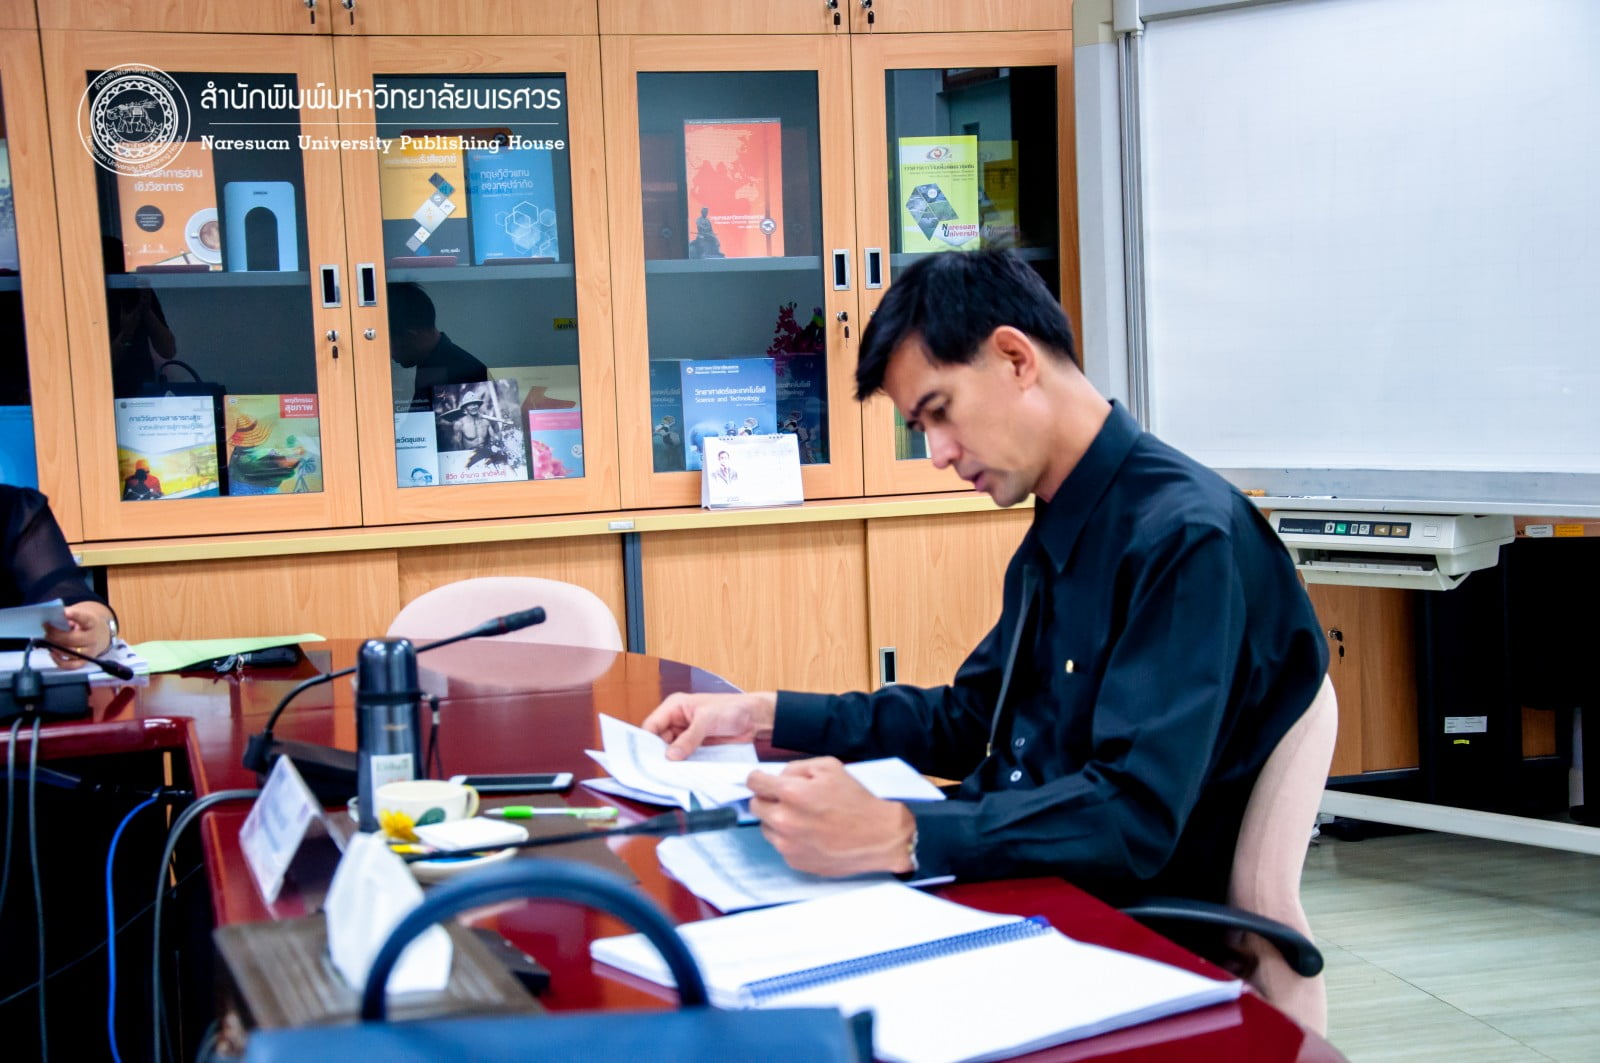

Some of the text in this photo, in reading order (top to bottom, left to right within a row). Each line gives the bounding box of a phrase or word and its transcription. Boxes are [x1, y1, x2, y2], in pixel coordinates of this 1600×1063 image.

[942, 223, 976, 231] Naresuan
[943, 230, 978, 238] University
[730, 395, 760, 403] Technology
[284, 404, 313, 414] สุขภาพ
